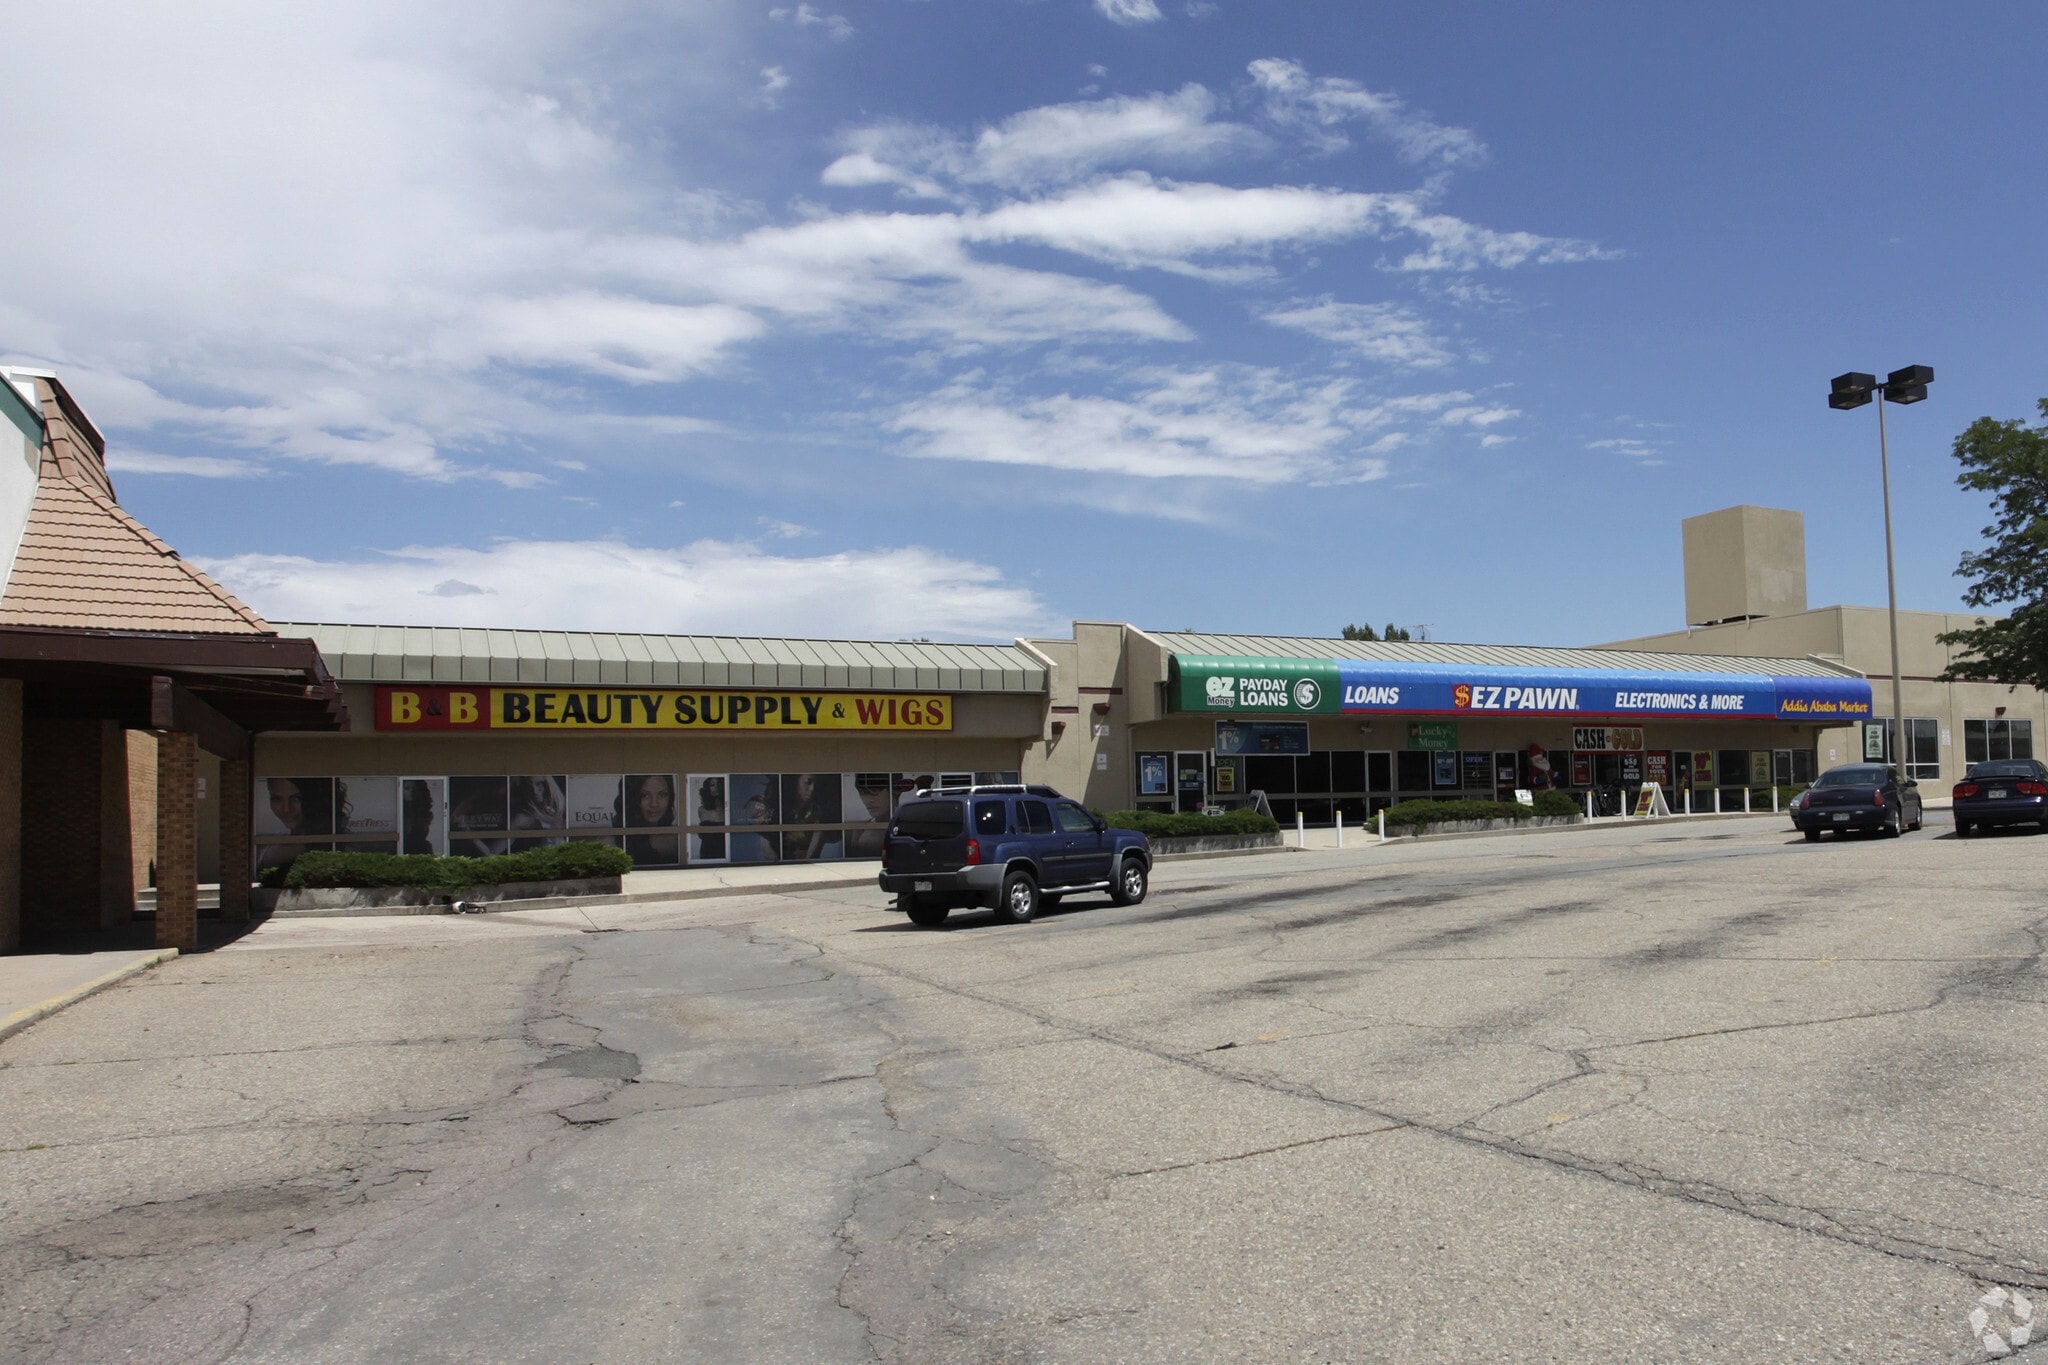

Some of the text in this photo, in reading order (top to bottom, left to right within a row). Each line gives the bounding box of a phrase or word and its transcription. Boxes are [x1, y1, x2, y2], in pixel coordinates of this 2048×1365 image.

[1239, 678, 1288, 691] PAYDAY
[1207, 695, 1235, 707] Money
[1240, 692, 1288, 706] LOANS
[1344, 686, 1400, 704] LOANS
[1615, 691, 1744, 710] ELECTRONICS & MORE
[391, 692, 945, 726] B & B BEAUTY SUPPLY & WIGS
[1781, 699, 1869, 713] Addis Ababa Market
[1418, 726, 1448, 739] Lucky
[1574, 728, 1642, 750] CASH GOLD
[1418, 738, 1448, 749] Money
[1648, 756, 1666, 764] CASH
